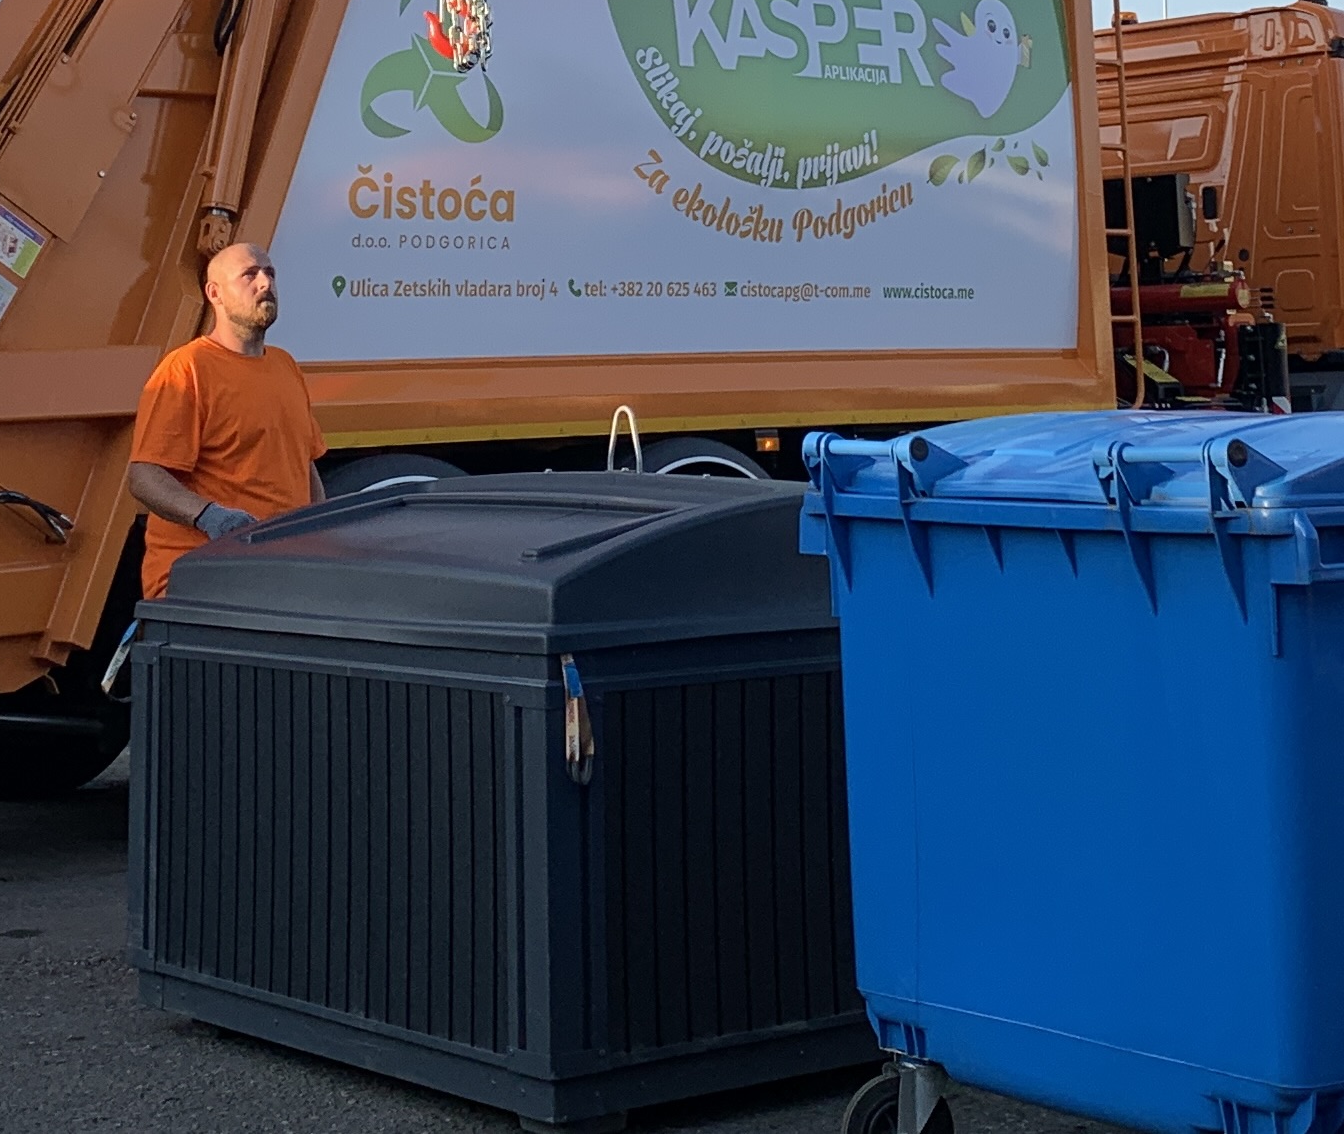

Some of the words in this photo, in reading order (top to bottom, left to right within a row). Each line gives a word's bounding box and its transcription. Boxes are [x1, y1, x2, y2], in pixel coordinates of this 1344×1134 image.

[824, 64, 888, 85] APLIKACIJA
[635, 46, 703, 141] Slikaj,
[699, 131, 790, 187] pošalji,
[796, 129, 879, 189] prijavi!
[348, 163, 515, 222] Čistoća
[633, 148, 671, 194] Za
[672, 182, 784, 243] ekološku
[792, 182, 914, 243] Podgoricu
[351, 234, 391, 249] d.o.o.
[399, 234, 511, 250] PODGORICA
[350, 278, 389, 298] Ulica
[393, 278, 451, 298] Zetskih
[455, 278, 512, 298] vladara
[516, 278, 545, 301] broj
[549, 281, 559, 297] 4
[584, 281, 607, 298] tel:
[611, 282, 643, 298] +382
[646, 282, 663, 298] 20
[666, 282, 690, 298] 625
[693, 282, 717, 298] 463
[740, 280, 871, 302] cistocapg@t-com.me
[883, 282, 975, 300] www.cistoca.me
